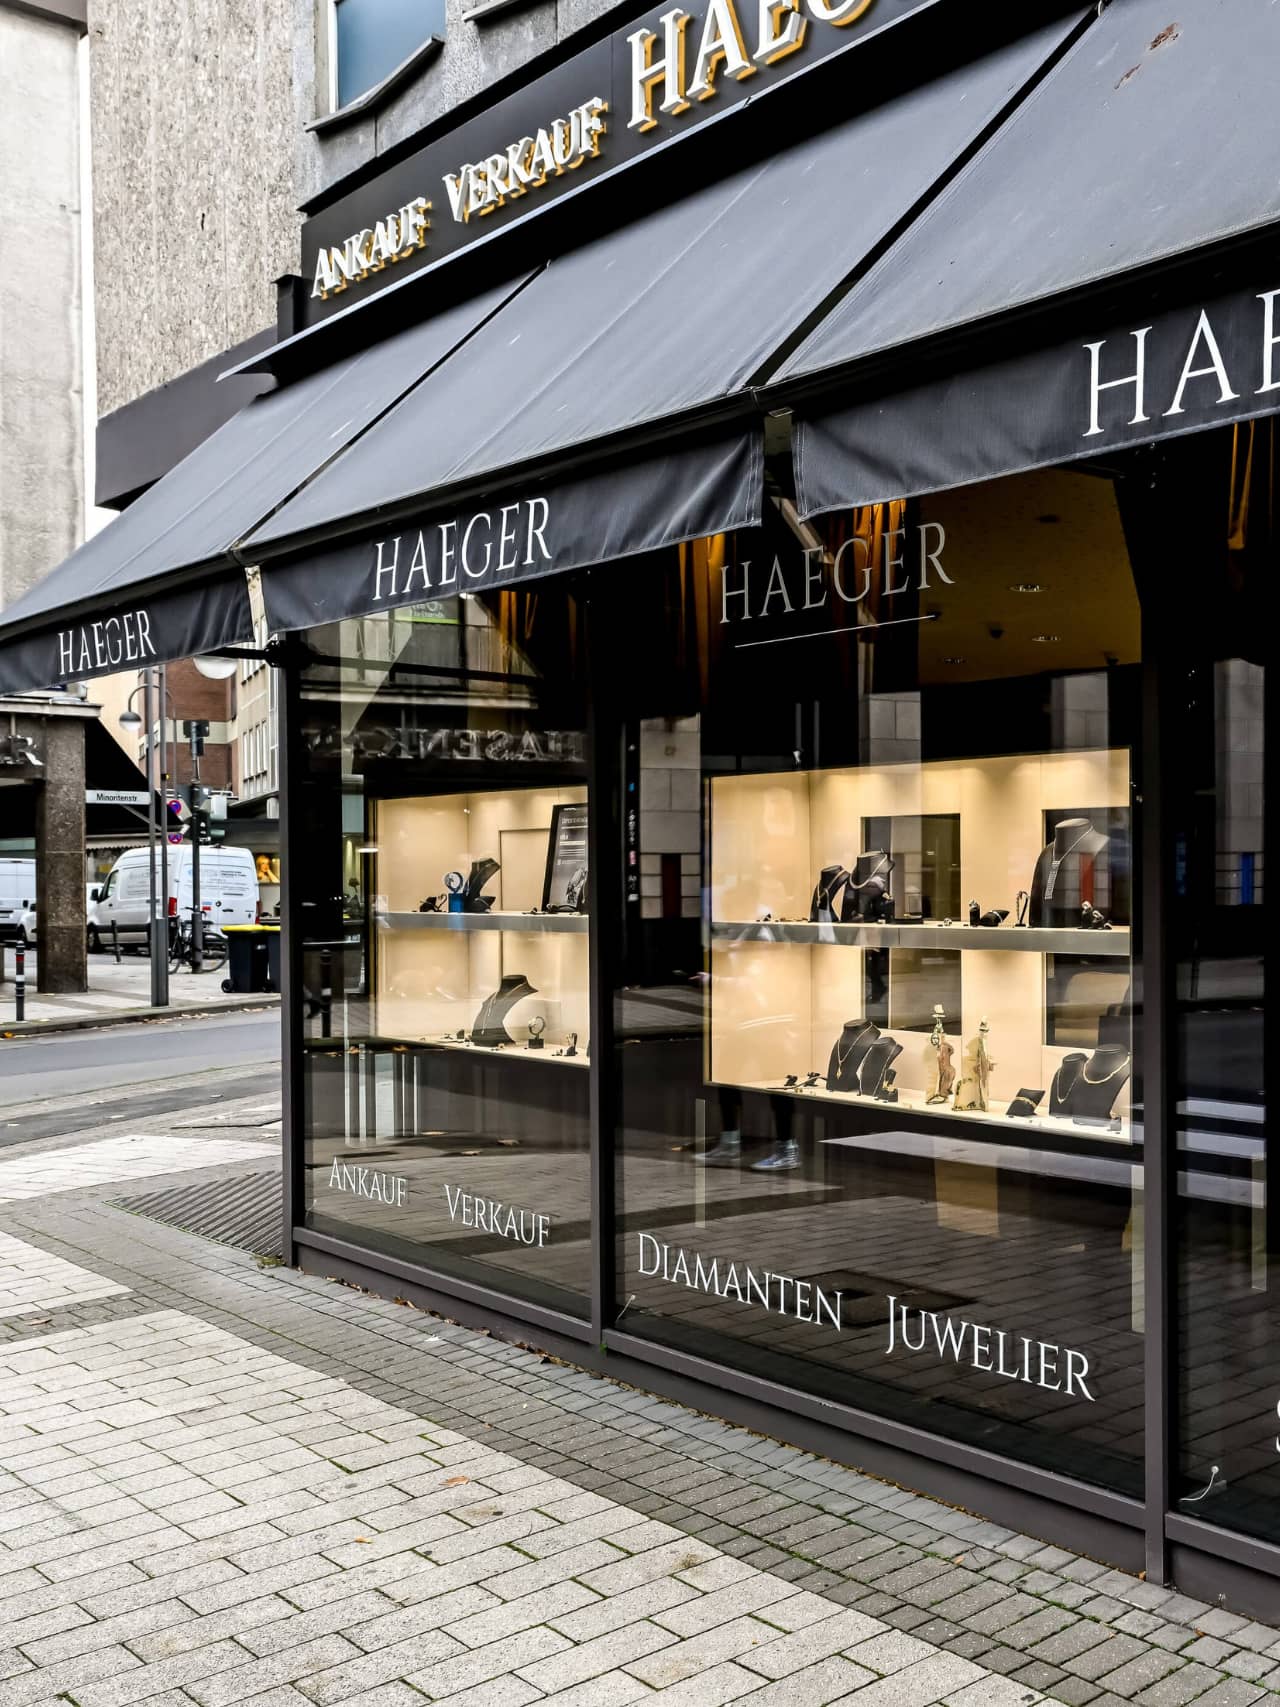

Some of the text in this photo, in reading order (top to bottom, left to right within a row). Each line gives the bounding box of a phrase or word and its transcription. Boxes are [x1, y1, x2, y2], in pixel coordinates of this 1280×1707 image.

[311, 0, 866, 299] ANKAUF VERKAUF HAE
[372, 497, 553, 600] HAEGER
[720, 522, 955, 624] HAEGER
[58, 610, 157, 675] HAEGER
[328, 1156, 550, 1248] ANKAUF VERKAUF
[637, 1232, 1097, 1402] DIAMANTEN JUWELIER
